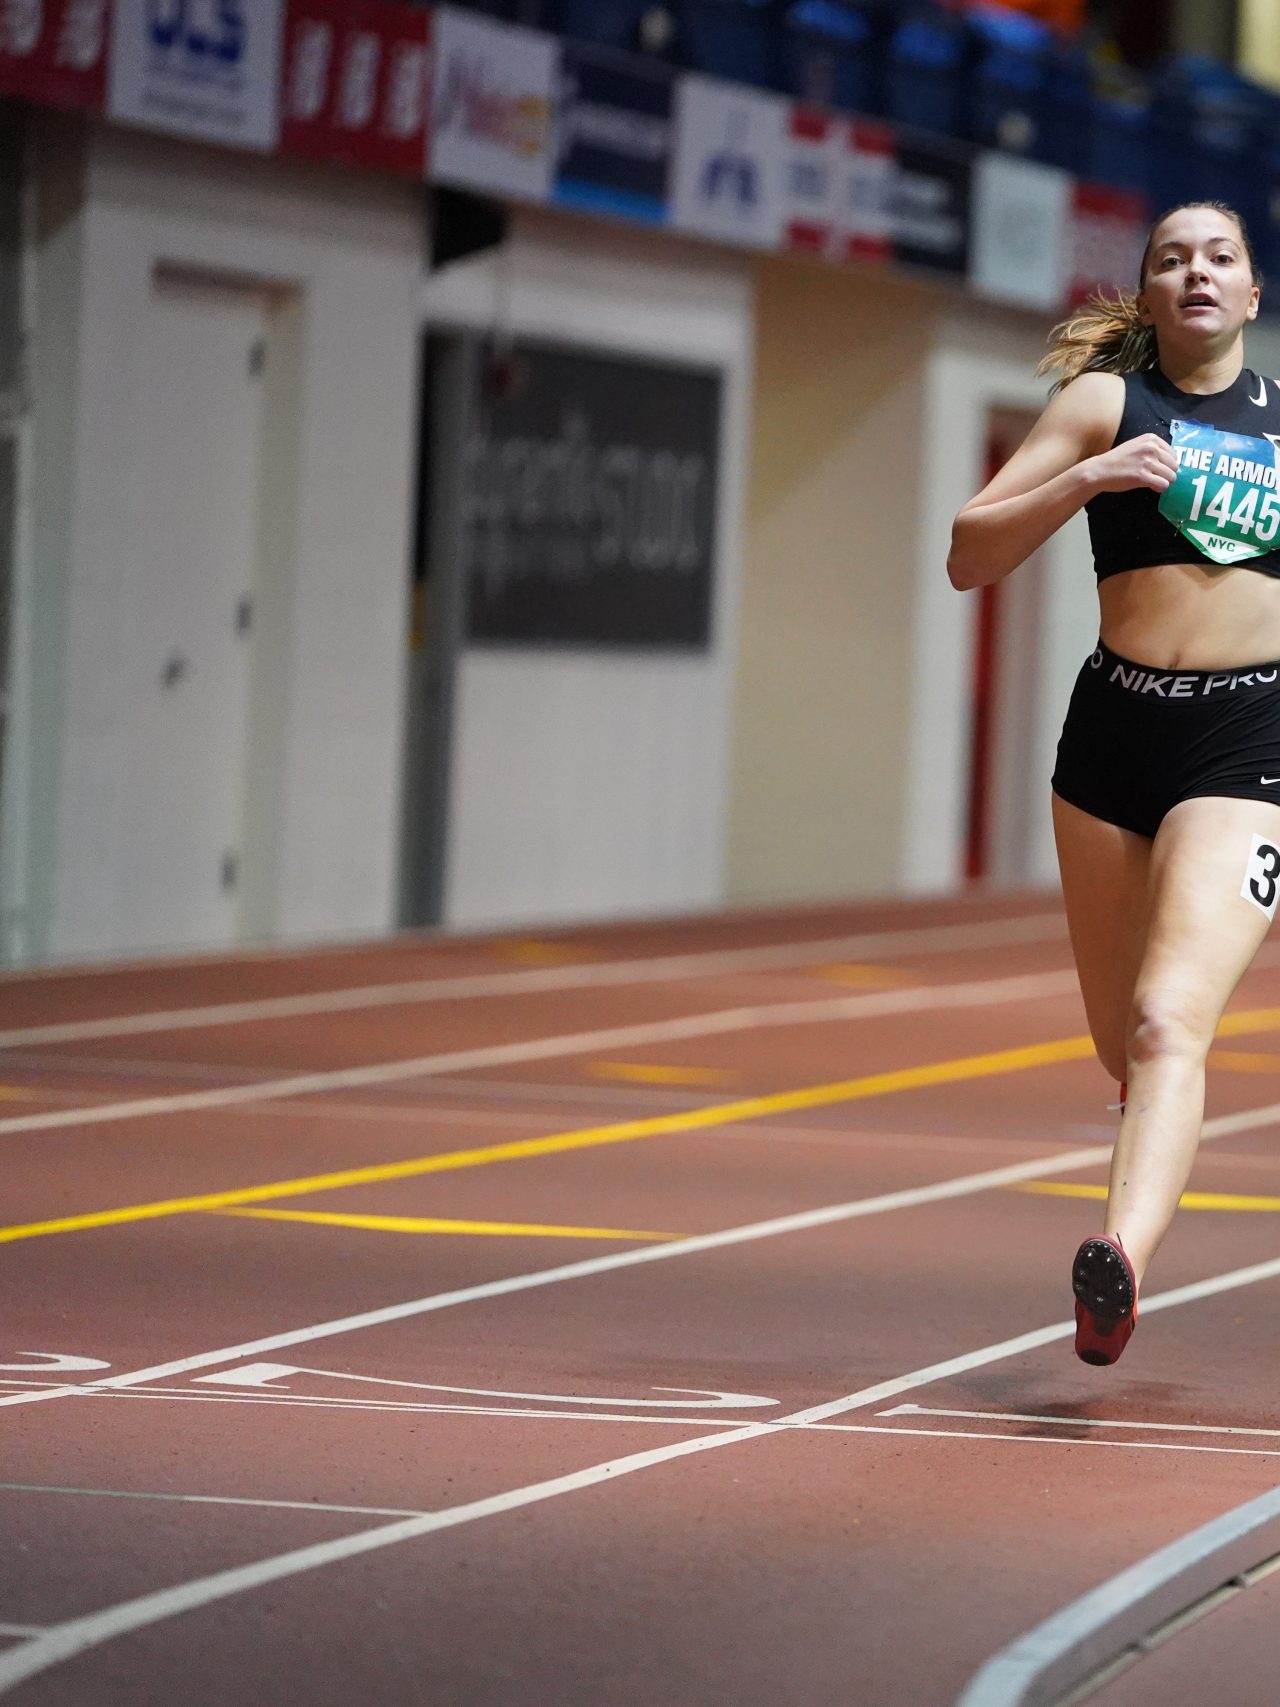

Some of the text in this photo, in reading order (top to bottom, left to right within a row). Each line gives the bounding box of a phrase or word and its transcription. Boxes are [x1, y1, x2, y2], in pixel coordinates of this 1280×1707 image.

[1174, 445, 1214, 472] THE
[1207, 536, 1236, 553] NYC
[1109, 664, 1199, 698] NIKE
